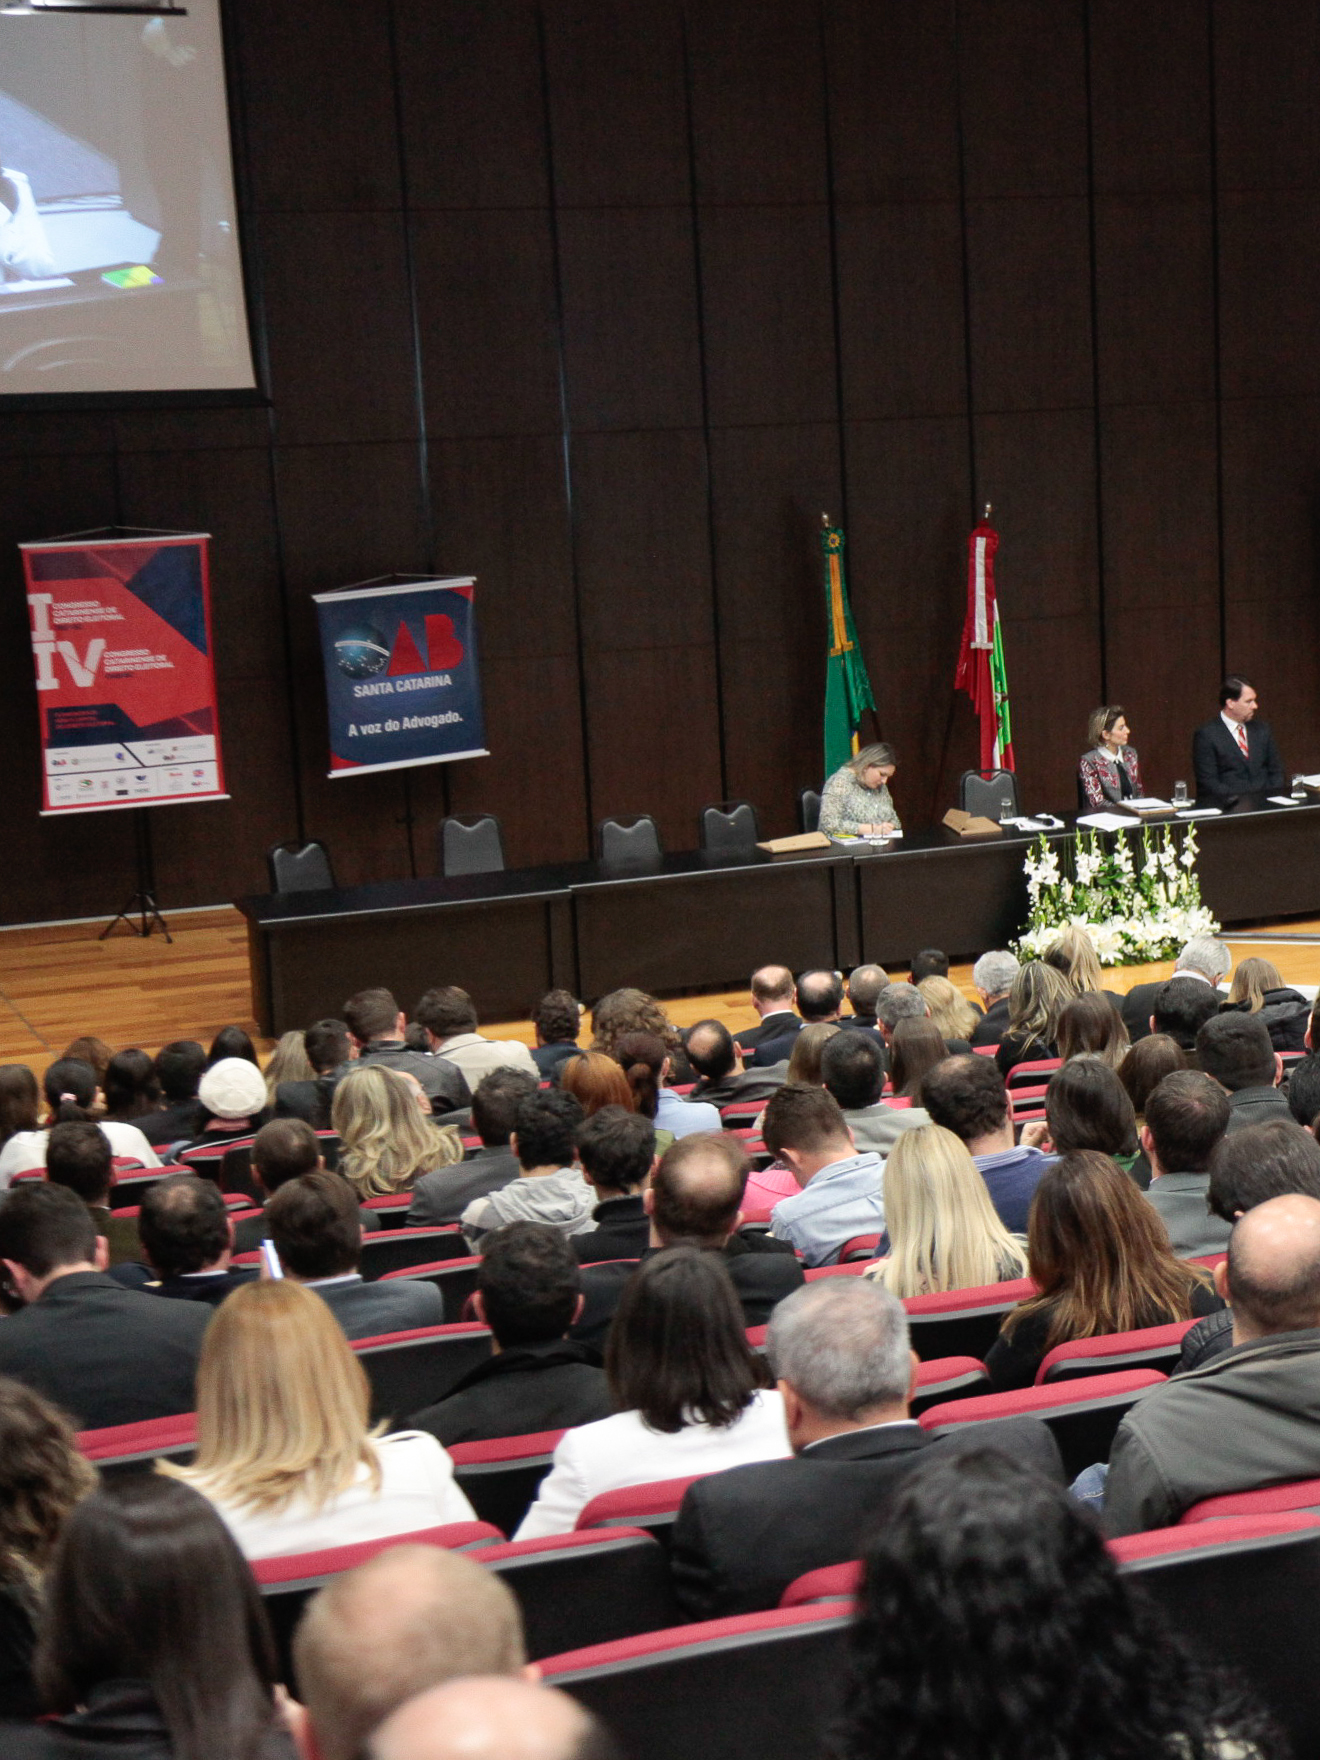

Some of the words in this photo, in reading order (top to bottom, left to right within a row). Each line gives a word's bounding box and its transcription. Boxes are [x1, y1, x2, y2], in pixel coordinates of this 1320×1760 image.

[32, 638, 107, 690] IV
[353, 681, 394, 698] SANTA
[395, 674, 453, 693] CATARINA
[348, 723, 358, 737] A
[360, 723, 382, 735] voz
[384, 719, 400, 732] do
[403, 710, 464, 730] Advogado.
